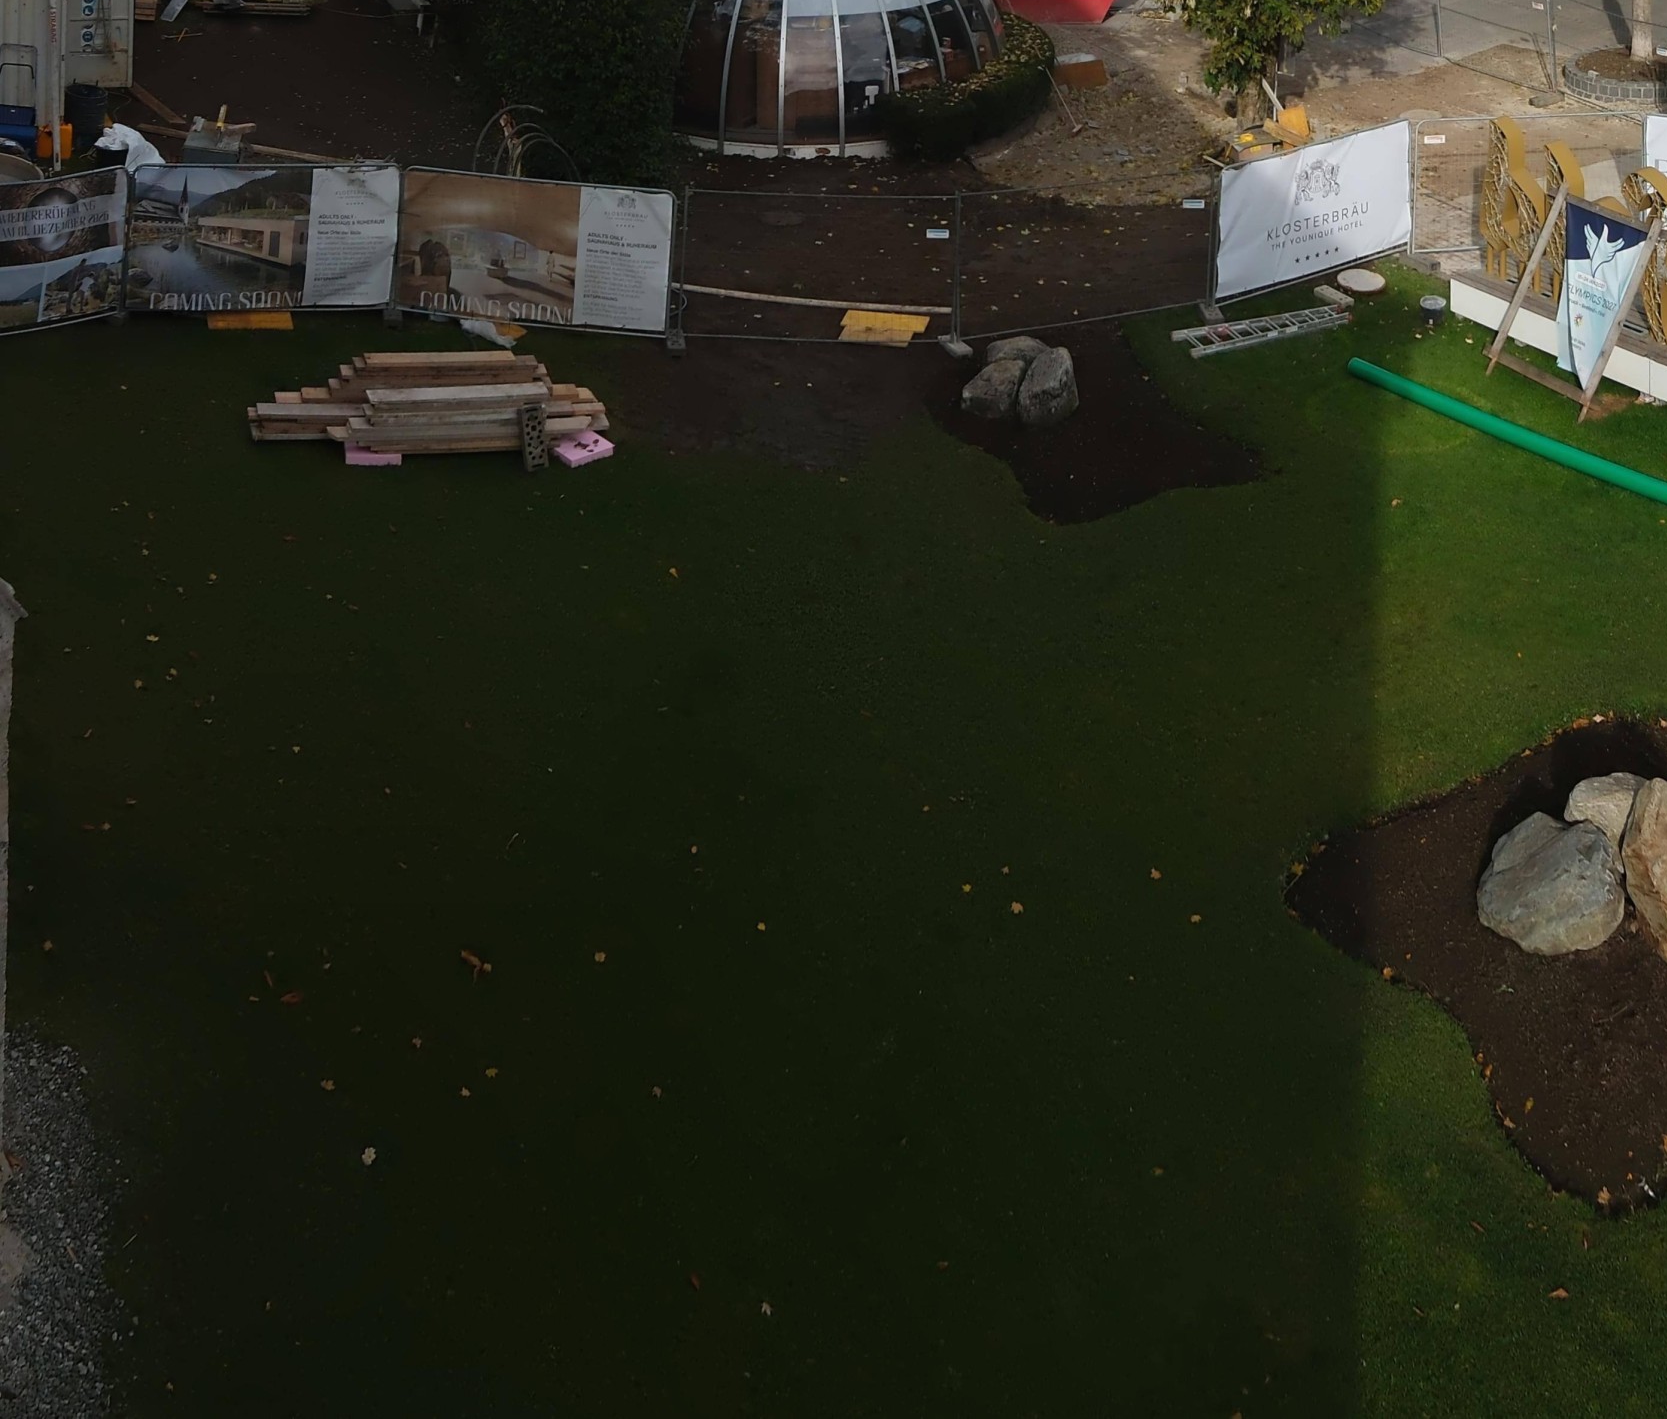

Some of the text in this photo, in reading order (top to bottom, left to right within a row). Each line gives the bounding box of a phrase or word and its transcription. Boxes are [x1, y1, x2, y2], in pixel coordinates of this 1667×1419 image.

[587, 232, 608, 240] ADULTS
[1266, 202, 1369, 241] KLOSTERBRÄU
[1271, 220, 1363, 251] THE YOUNIQUE HOTEL
[419, 289, 501, 319] COMING
[506, 301, 574, 326] SOON!
[1601, 297, 1617, 311] 2027
